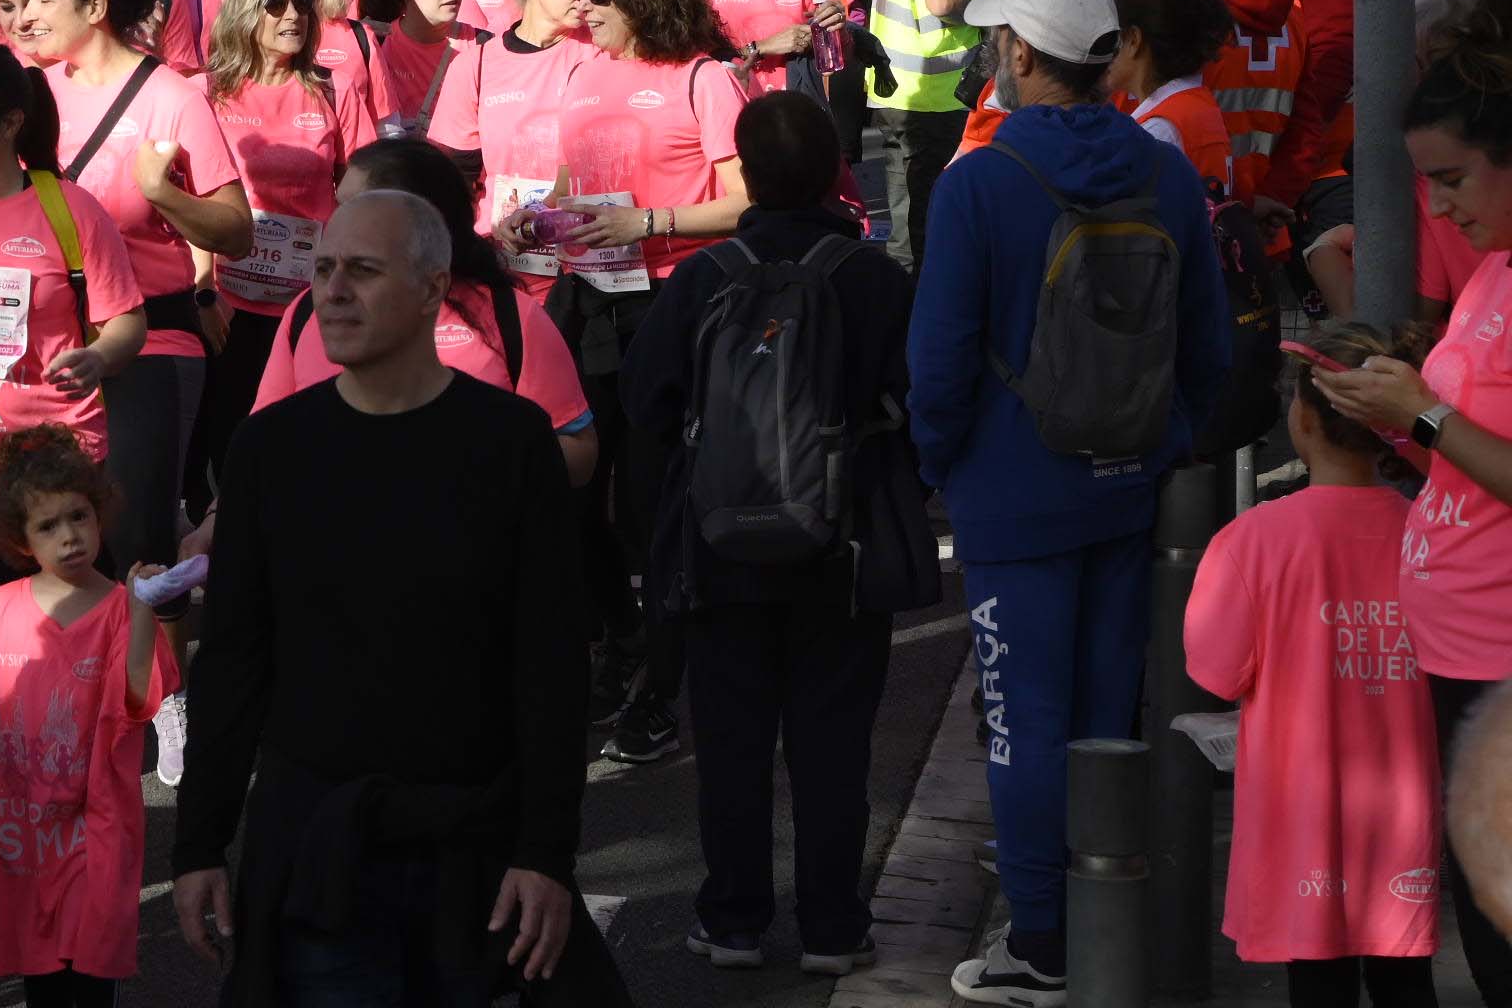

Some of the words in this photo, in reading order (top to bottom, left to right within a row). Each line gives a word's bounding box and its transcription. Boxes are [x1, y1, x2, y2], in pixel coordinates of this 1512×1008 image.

[254, 226, 288, 239] STURIANA
[250, 245, 282, 263] 016
[249, 263, 276, 274] 17270
[434, 334, 470, 344] STURIANA
[1093, 466, 1120, 478] SINCE
[1123, 463, 1142, 474] 1899
[1337, 627, 1368, 653] DE
[1380, 628, 1414, 654] LA
[1335, 655, 1419, 681] MUJER
[971, 596, 1011, 767] BARÇA
